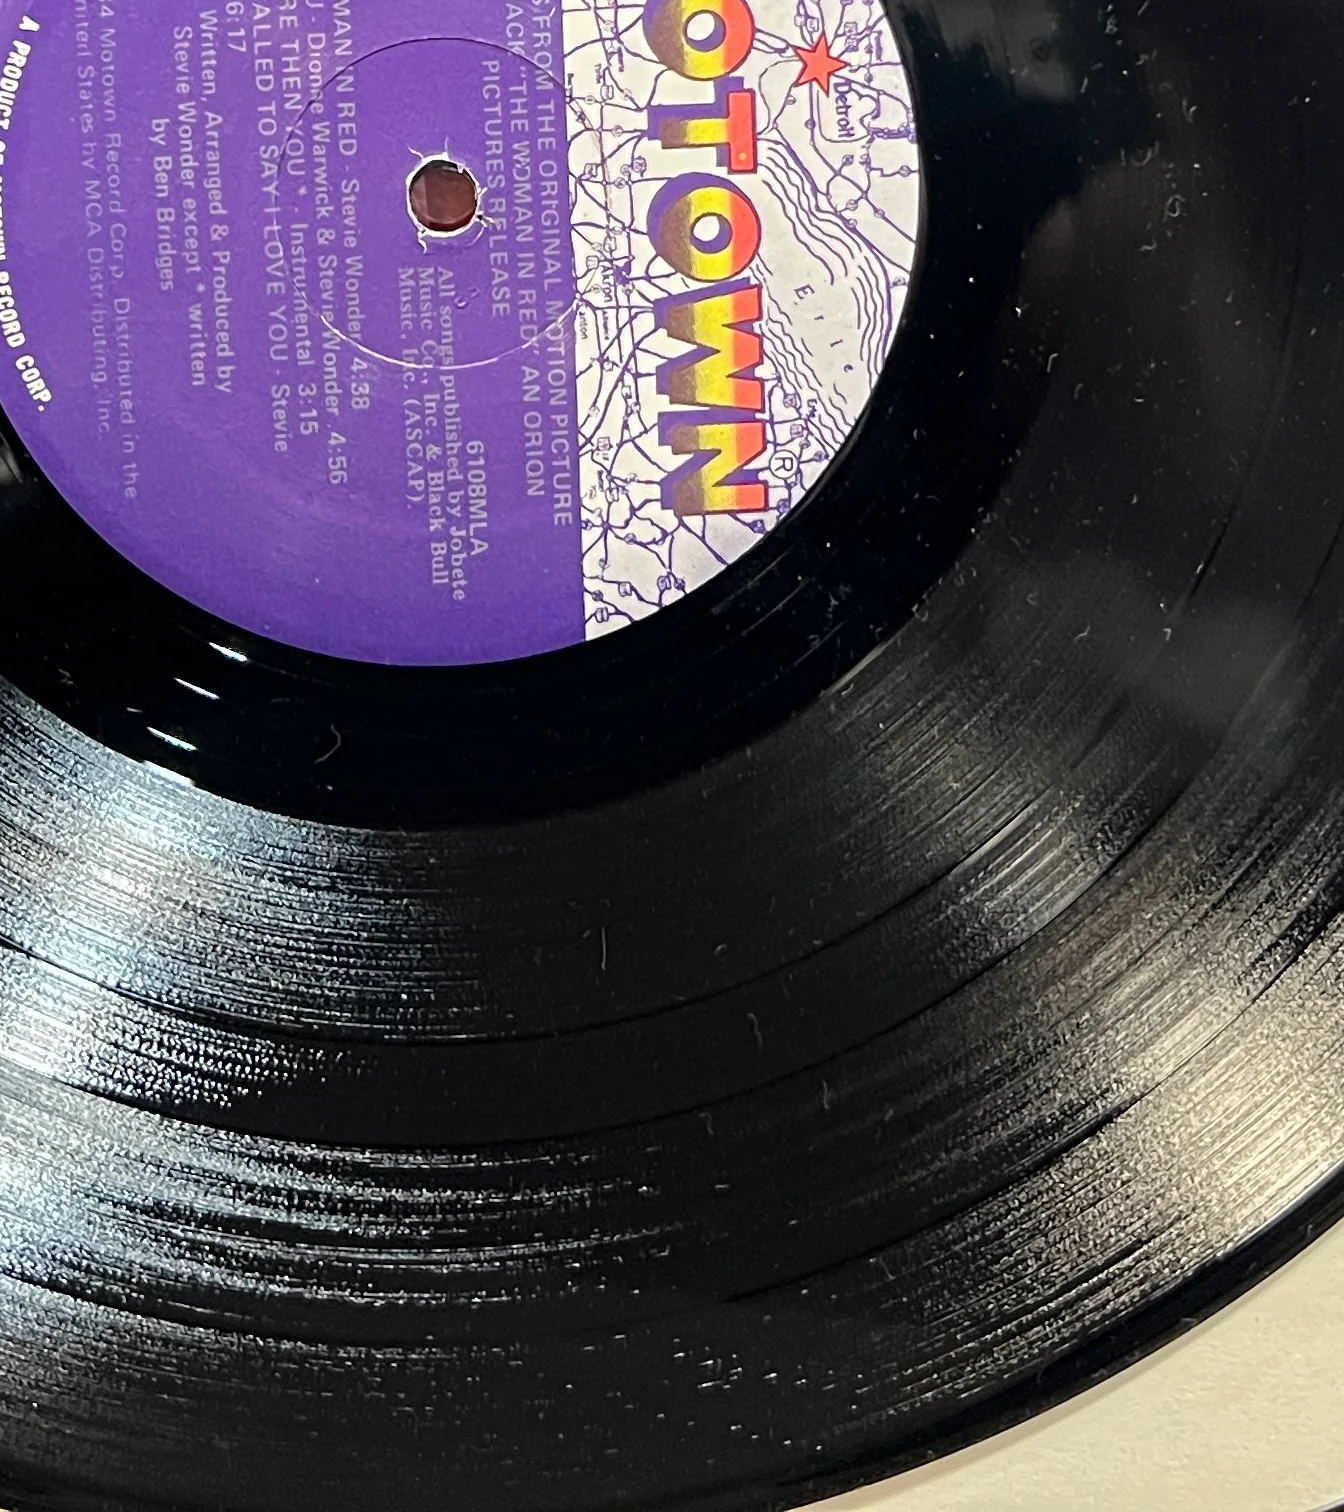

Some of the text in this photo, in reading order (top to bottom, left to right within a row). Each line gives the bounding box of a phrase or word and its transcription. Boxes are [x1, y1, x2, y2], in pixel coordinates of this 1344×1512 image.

[19, 16, 40, 32] A
[226, 1, 246, 52] 6:17
[533, 17, 555, 90] FROM
[76, 66, 95, 134] States
[100, 28, 118, 122] Motown
[281, 40, 301, 110] THEN
[308, 33, 326, 114] Dionne
[336, 67, 354, 92] IN
[256, 100, 277, 136] TO
[337, 102, 357, 155] RED
[536, 100, 556, 150] THE
[833, 82, 855, 138] Detroit
[81, 143, 98, 168] by
[105, 134, 126, 212] Record
[259, 146, 280, 196] SAY
[285, 124, 306, 176] YOU
[312, 122, 334, 219] Warwick
[86, 180, 102, 236] MCA
[148, 118, 176, 291] by Ben Bridges
[174, 26, 208, 386] Stevie Wonder except written
[200, 10, 236, 392] Written, Arranged & Produced by
[341, 180, 360, 247] Stevie
[482, 60, 509, 316] PICTURES RELEASE
[512, 141, 535, 242] WOMAN
[317, 228, 335, 244] &
[539, 160, 562, 290] ORIGINAL
[263, 225, 286, 295] LOVE
[318, 256, 337, 322] Stevie
[517, 253, 534, 282] IN
[290, 224, 314, 366] Instrumental
[344, 256, 365, 340] Wonder
[417, 268, 434, 329] Music
[113, 298, 136, 424] Distributed
[268, 306, 288, 360] YOU
[545, 301, 568, 406] MOTION
[15, 355, 53, 412] CORP.
[322, 330, 342, 415] Wonder
[352, 358, 369, 409] 4:38
[521, 366, 540, 401] AN
[271, 384, 290, 452] Stevie
[299, 383, 318, 434] 3:15
[424, 394, 440, 436] Inc.
[438, 268, 467, 600] All songs published by Jobete
[122, 434, 138, 453] in
[328, 432, 346, 484] 4:56
[426, 444, 441, 460] &
[523, 411, 544, 496] ORION
[551, 414, 572, 526] PICTURE
[124, 463, 139, 499] the
[427, 471, 445, 532] Black
[466, 441, 488, 556] 6108MLA
[430, 542, 448, 585] Bull
